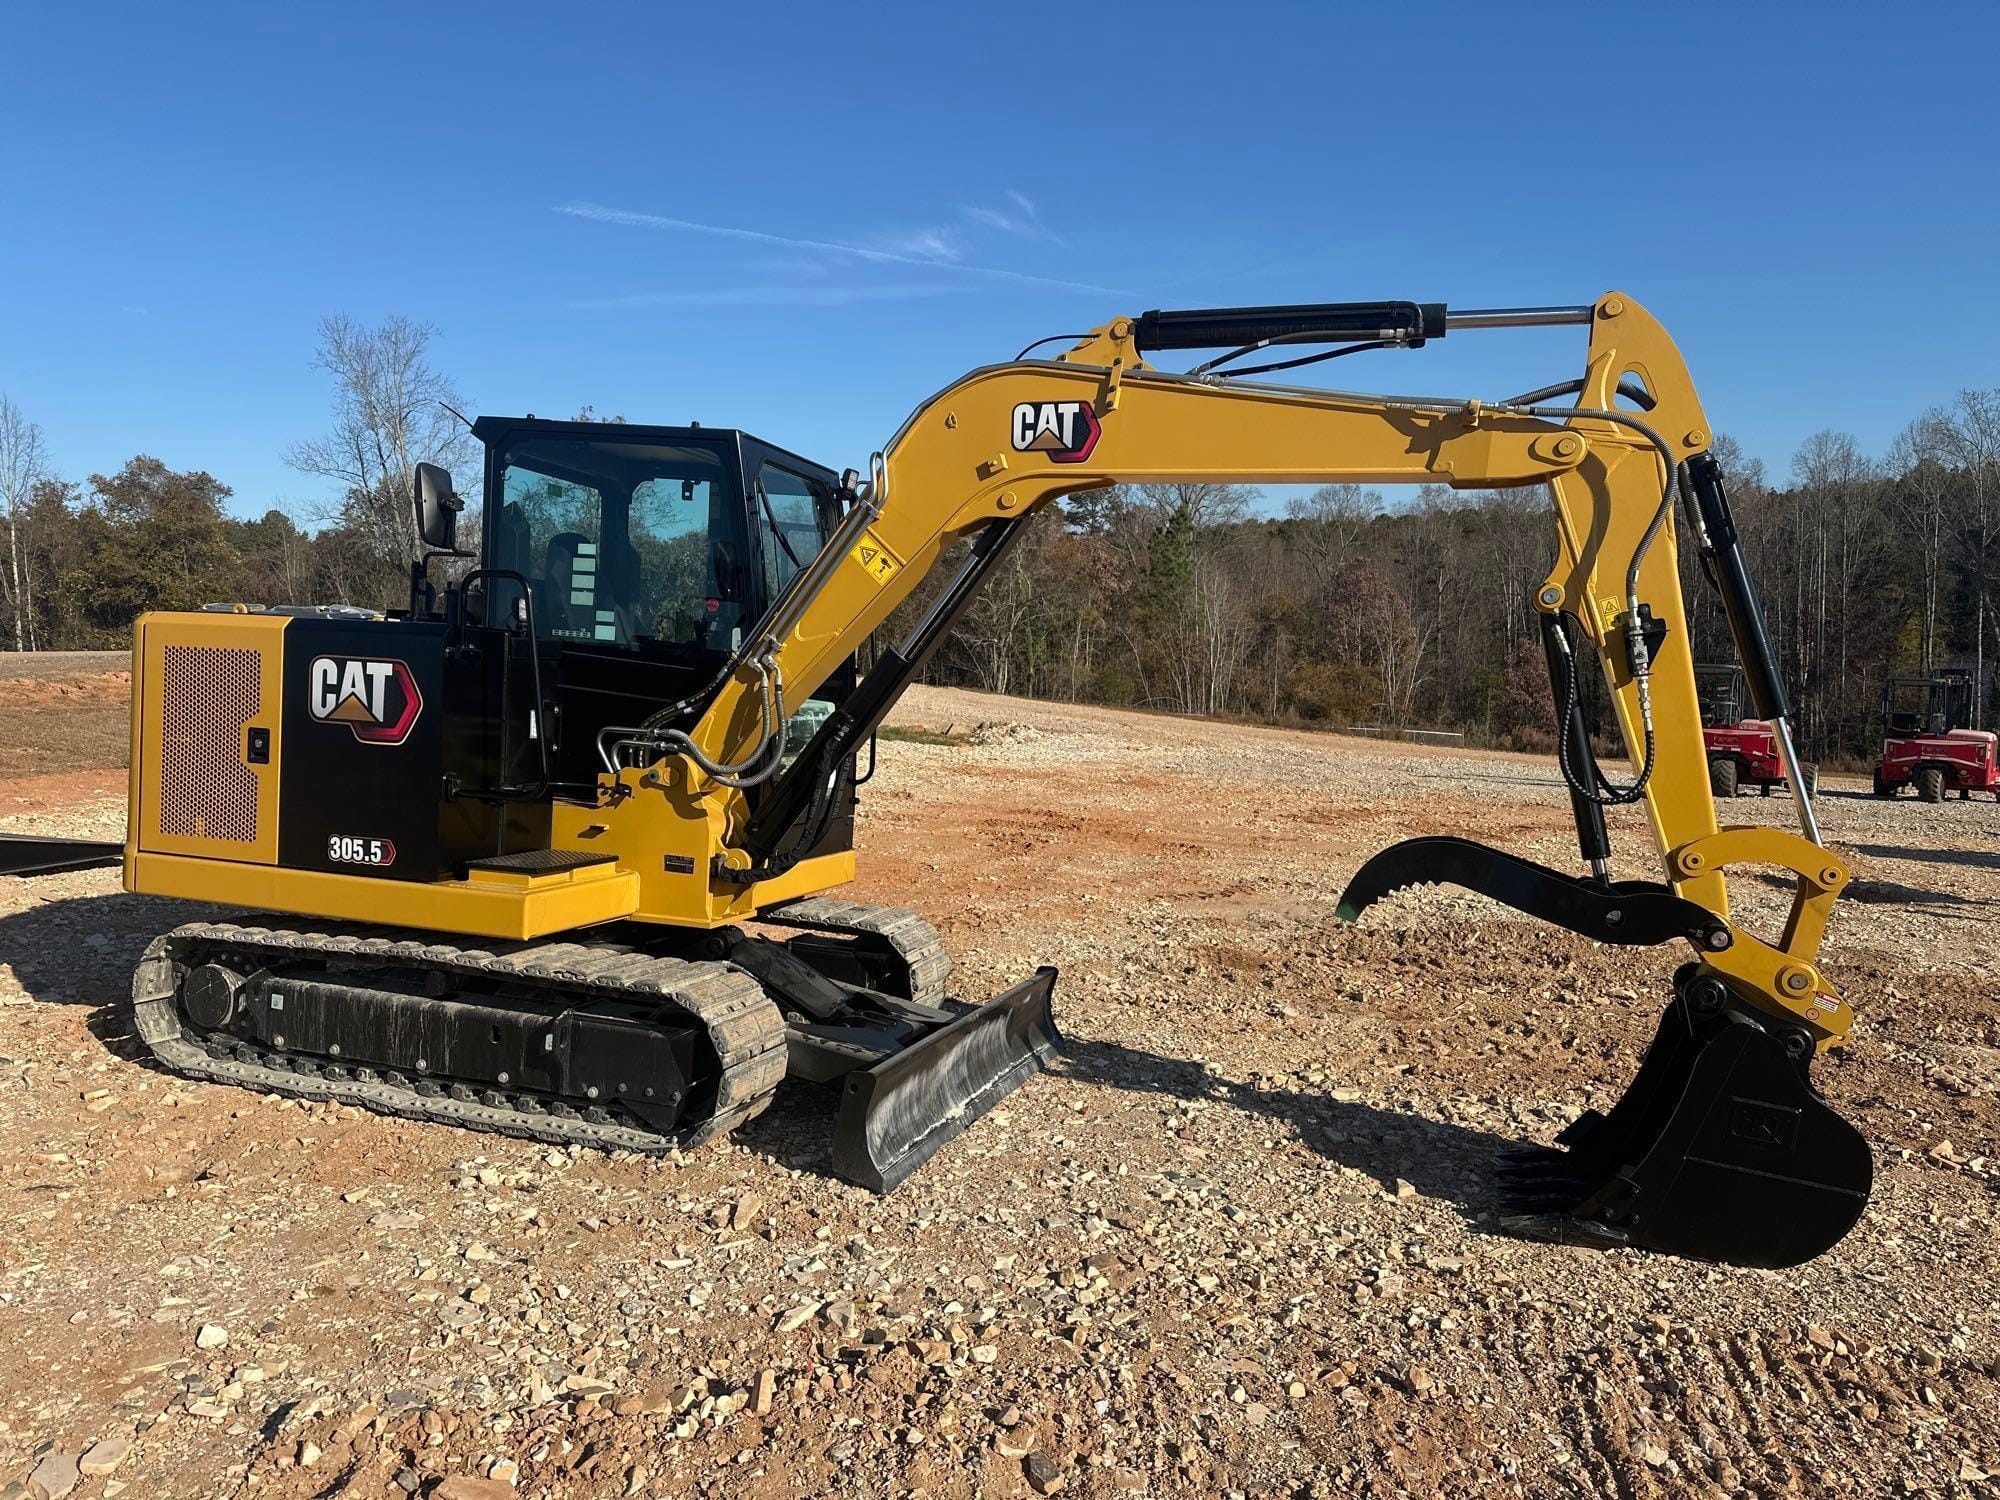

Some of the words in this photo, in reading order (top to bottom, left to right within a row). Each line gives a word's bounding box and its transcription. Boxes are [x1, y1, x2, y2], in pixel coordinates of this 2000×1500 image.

[1013, 403, 1080, 450] CAT
[312, 658, 393, 722] CAT
[330, 836, 382, 863] 305.5
